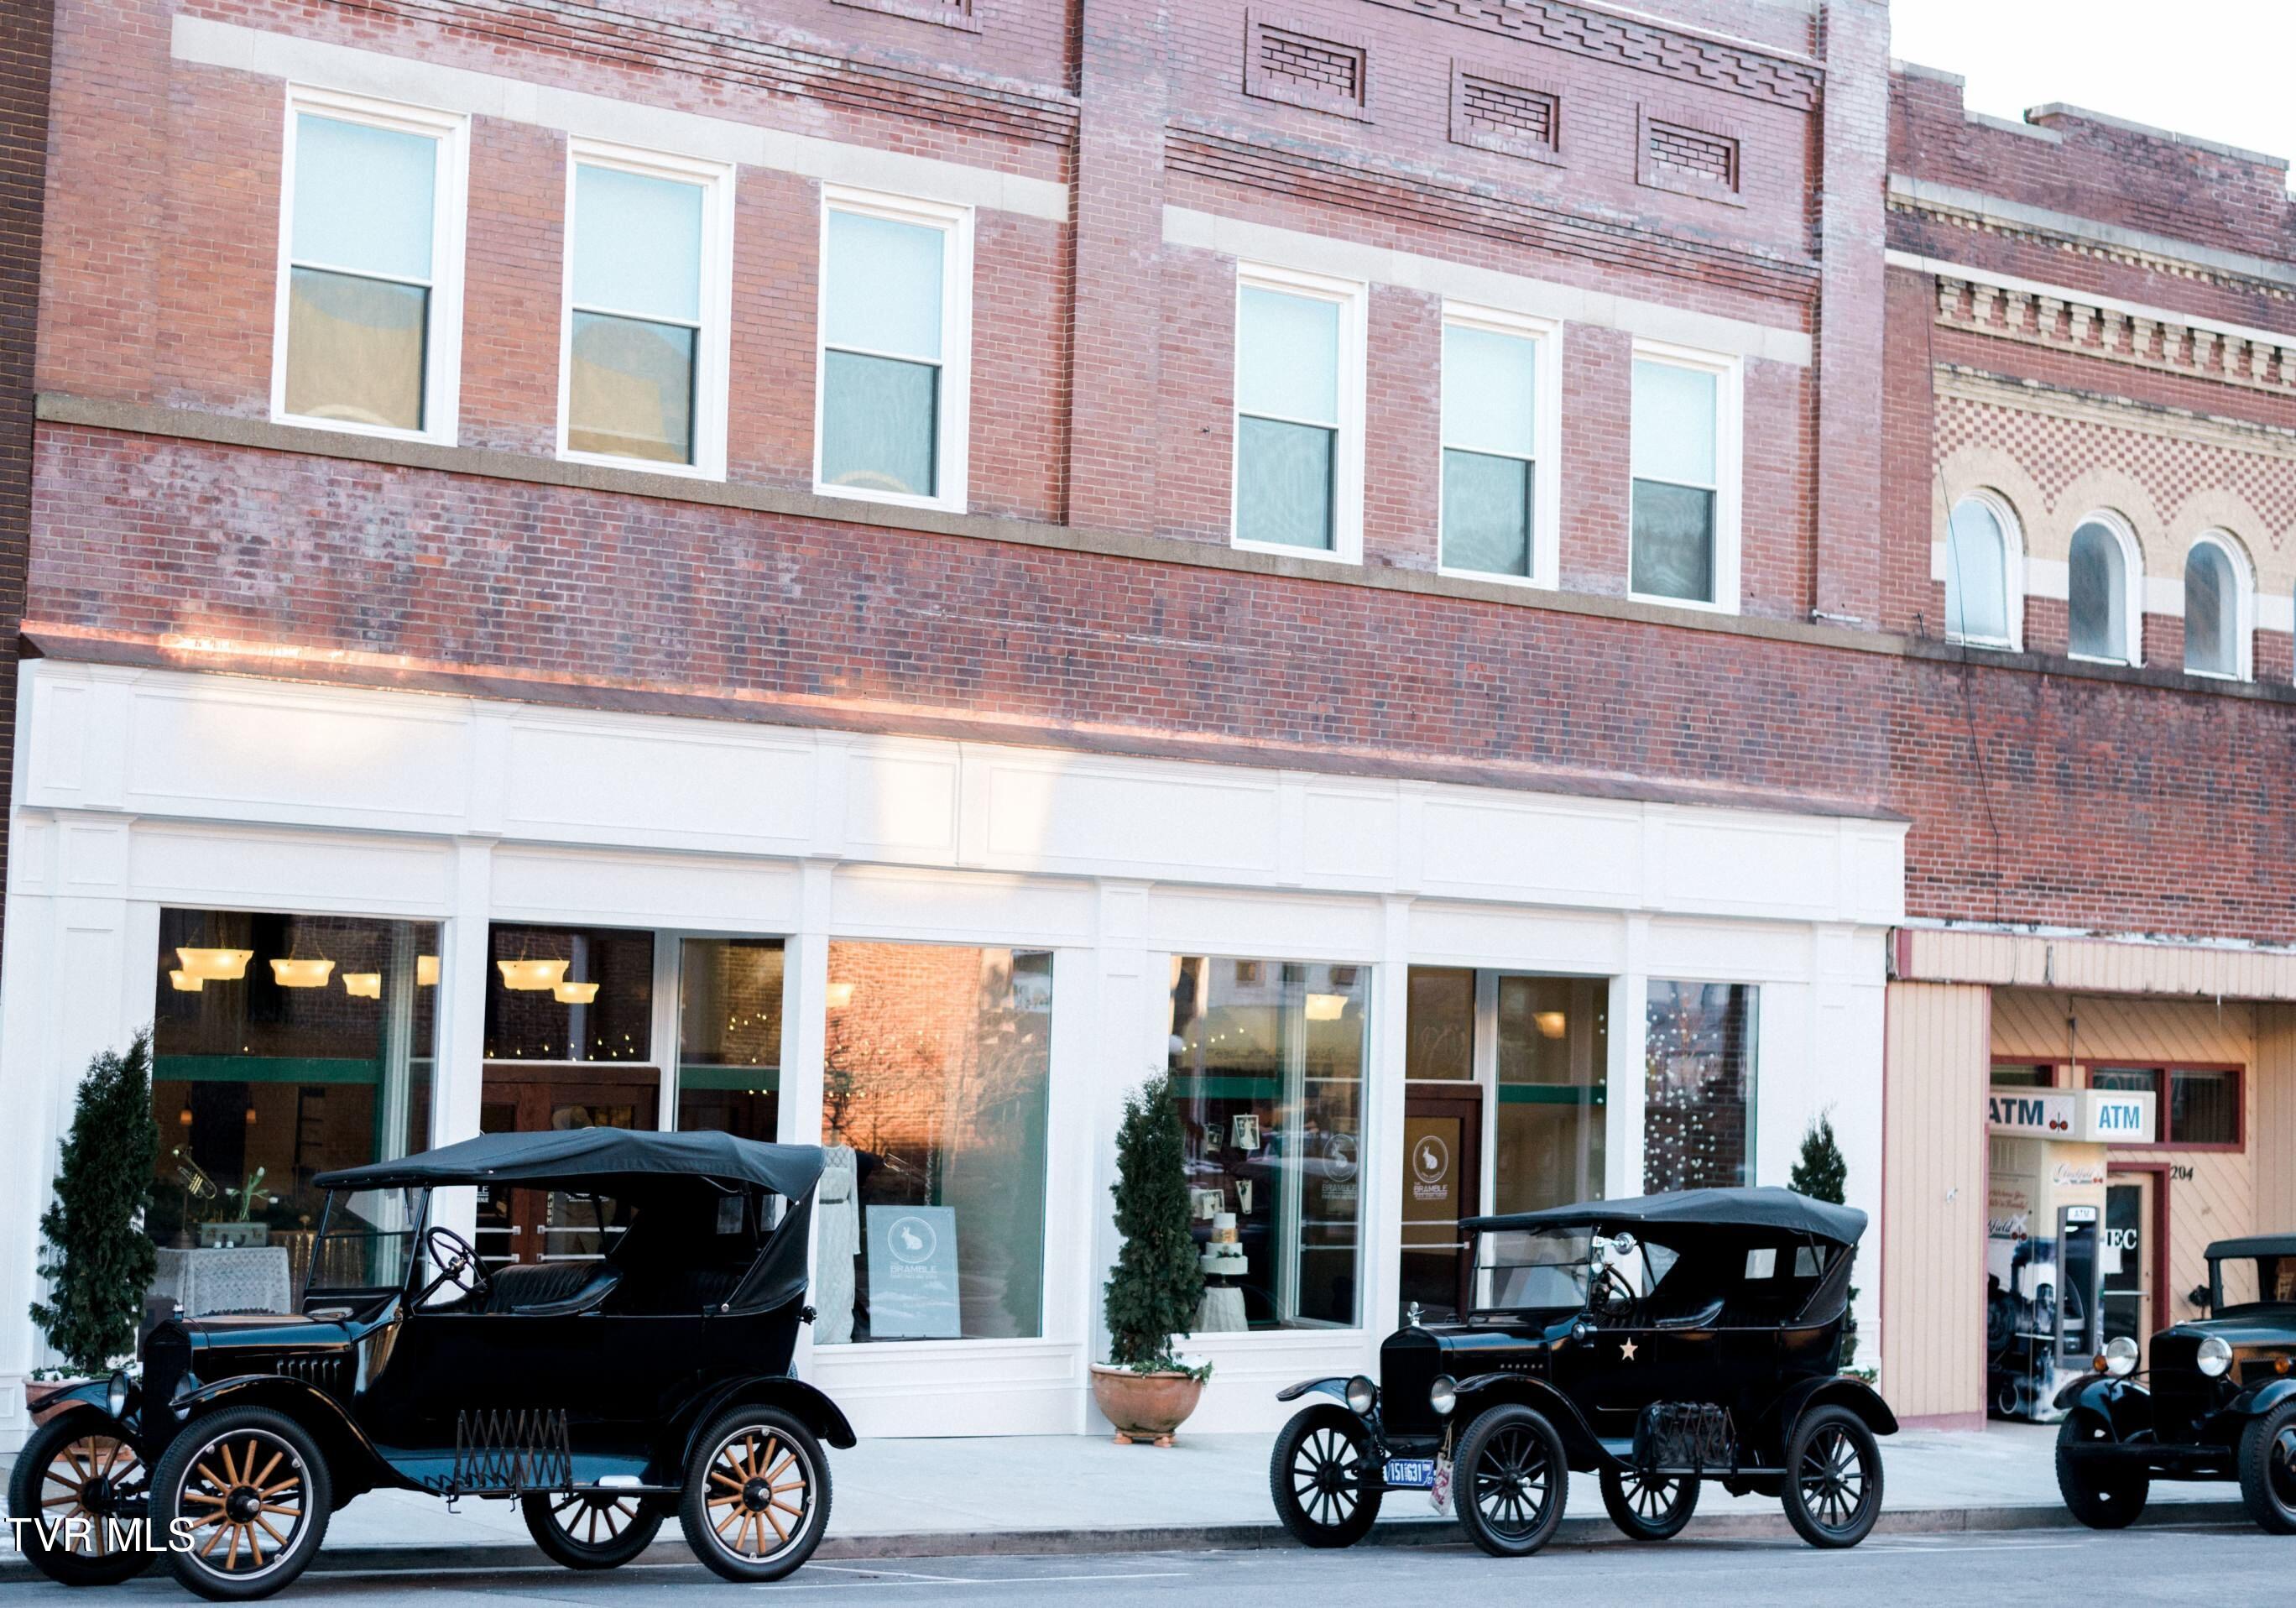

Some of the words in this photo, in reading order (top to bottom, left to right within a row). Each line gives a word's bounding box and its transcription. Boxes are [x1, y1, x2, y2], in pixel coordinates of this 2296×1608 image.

[1989, 1098, 2044, 1125] ATM
[2099, 1105, 2140, 1129] ATM
[2171, 1166, 2194, 1182] 204
[1413, 1184, 1448, 1193] BRAMBLE
[890, 1265, 937, 1273] BRAMBLE
